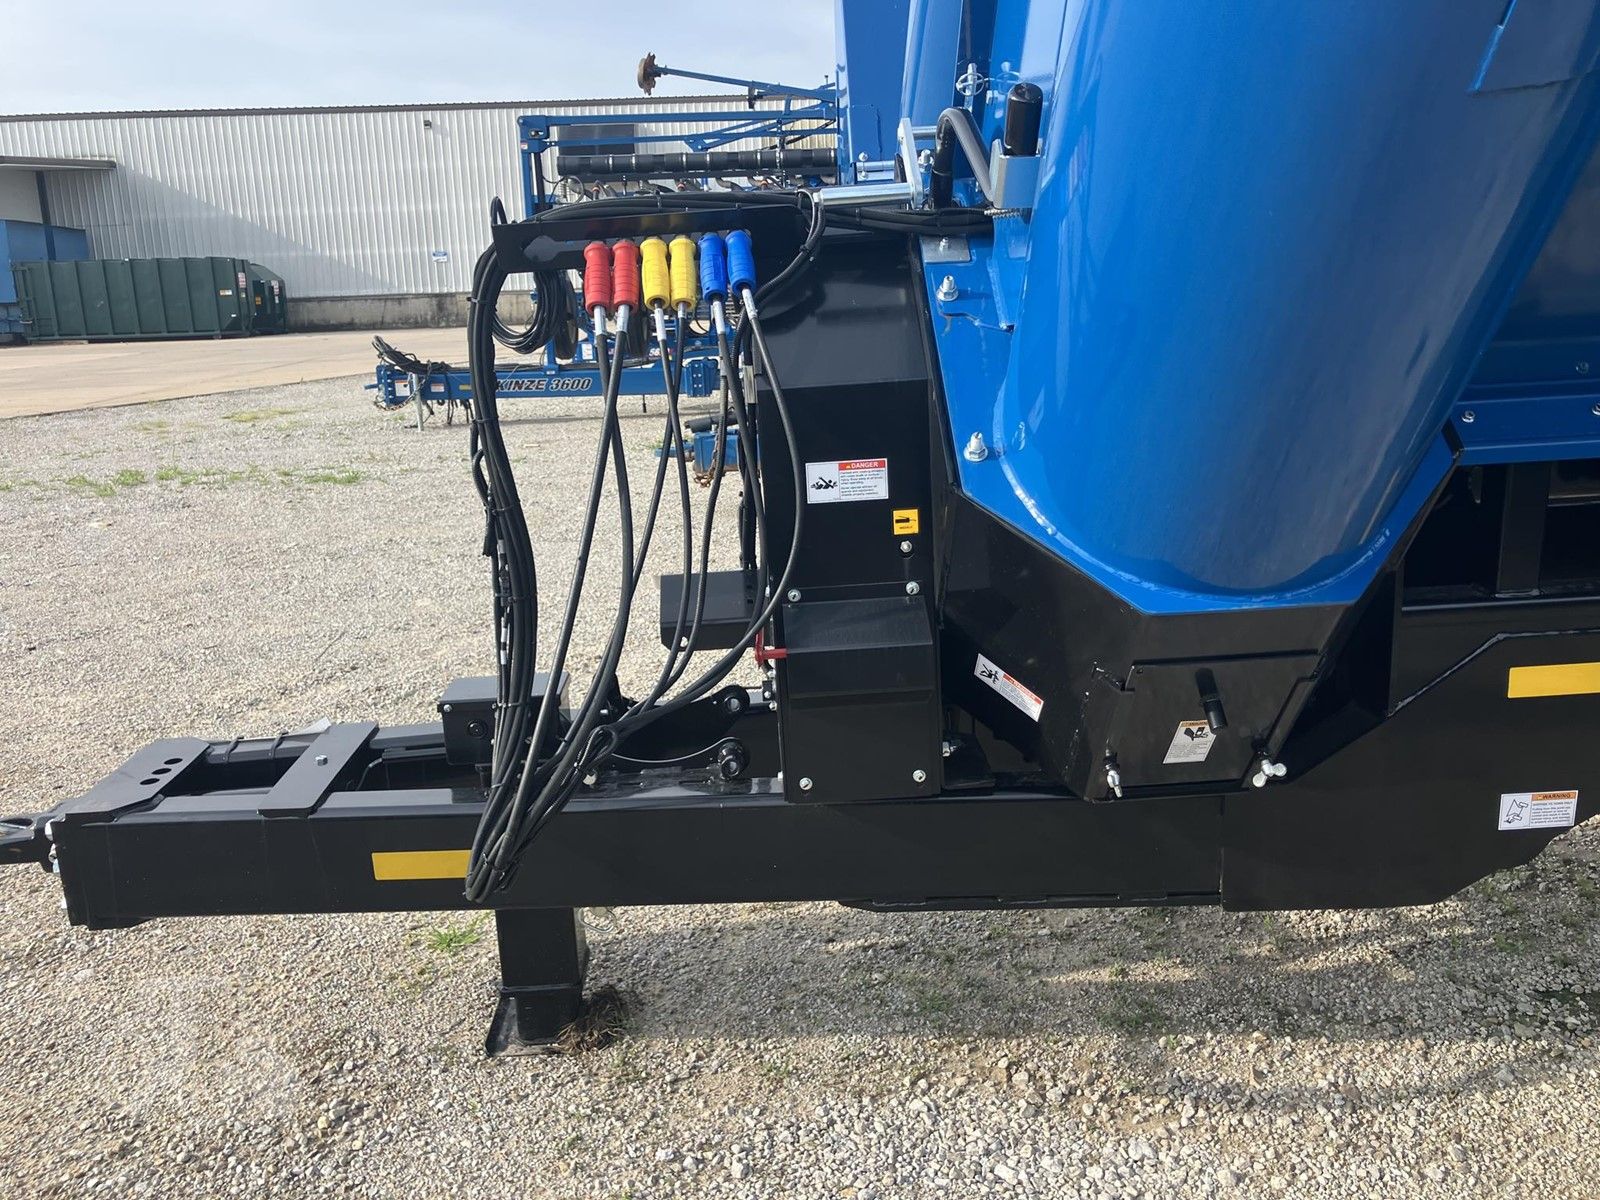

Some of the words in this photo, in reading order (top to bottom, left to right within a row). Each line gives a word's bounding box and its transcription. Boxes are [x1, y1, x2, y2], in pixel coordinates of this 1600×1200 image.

[496, 378, 548, 392] KINZE
[550, 377, 592, 391] 3600
[851, 461, 879, 470] DANGER
[1542, 792, 1571, 800] WARNING
